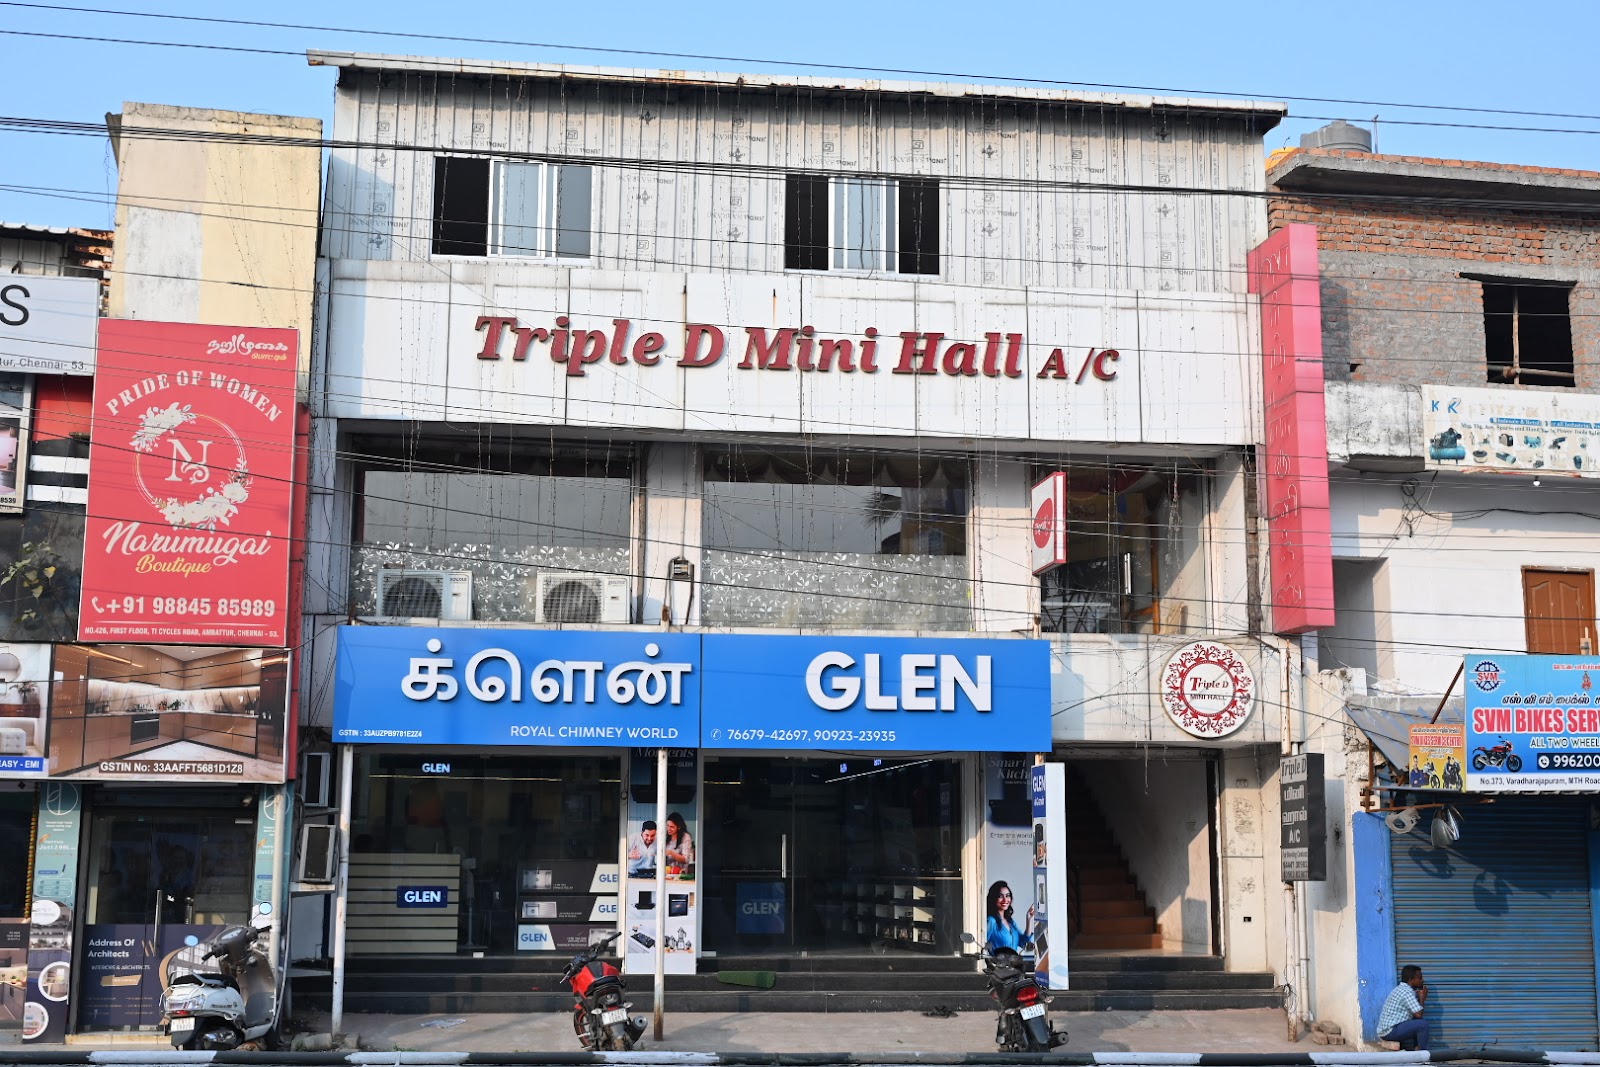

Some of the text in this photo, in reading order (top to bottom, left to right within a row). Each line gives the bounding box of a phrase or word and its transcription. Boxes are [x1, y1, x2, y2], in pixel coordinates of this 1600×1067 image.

[0, 284, 30, 326] S
[475, 316, 1120, 384] Triple D Mini Hall A/C
[71, 361, 87, 370] 53.
[106, 370, 283, 422] PRIDE OF WOMEN
[102, 520, 272, 566] Narumugai
[136, 554, 212, 578] Boutique
[106, 596, 276, 617] +91 98845 85989
[84, 627, 108, 635] NO.426,
[400, 638, 692, 706] க்ளென்
[1478, 672, 1498, 681] SVM
[805, 651, 992, 712] GLEN
[1190, 678, 1229, 691] Triple D
[1502, 693, 1522, 704] எஸ்
[1524, 695, 1536, 704] வி
[1539, 694, 1554, 704] எம்
[1556, 693, 1590, 704] பைக்ஸ்
[1473, 708, 1511, 732] SVM
[1515, 708, 1563, 733] BIKES
[510, 726, 678, 739] ROYAL CHIMNEY WORLD
[728, 730, 896, 742] 76679-42697, 90923-23935
[1531, 738, 1546, 747] ALL
[1548, 738, 1568, 747] TWO
[634, 748, 694, 758] Moents
[100, 762, 243, 774] GSTIN No: 33AAFFT5681D1Z8
[988, 756, 1026, 768] Smart
[422, 763, 450, 774] GLEN
[1281, 758, 1307, 779] Triple D
[1032, 775, 1046, 793] GLEN
[1506, 778, 1567, 786] Varadharajapuram,
[1288, 829, 1301, 844] A/C
[404, 890, 441, 904] GLEN
[742, 902, 779, 914] GLEN
[88, 938, 135, 947] Address Of
[521, 933, 547, 942] GLEN
[88, 949, 129, 958] Architects
